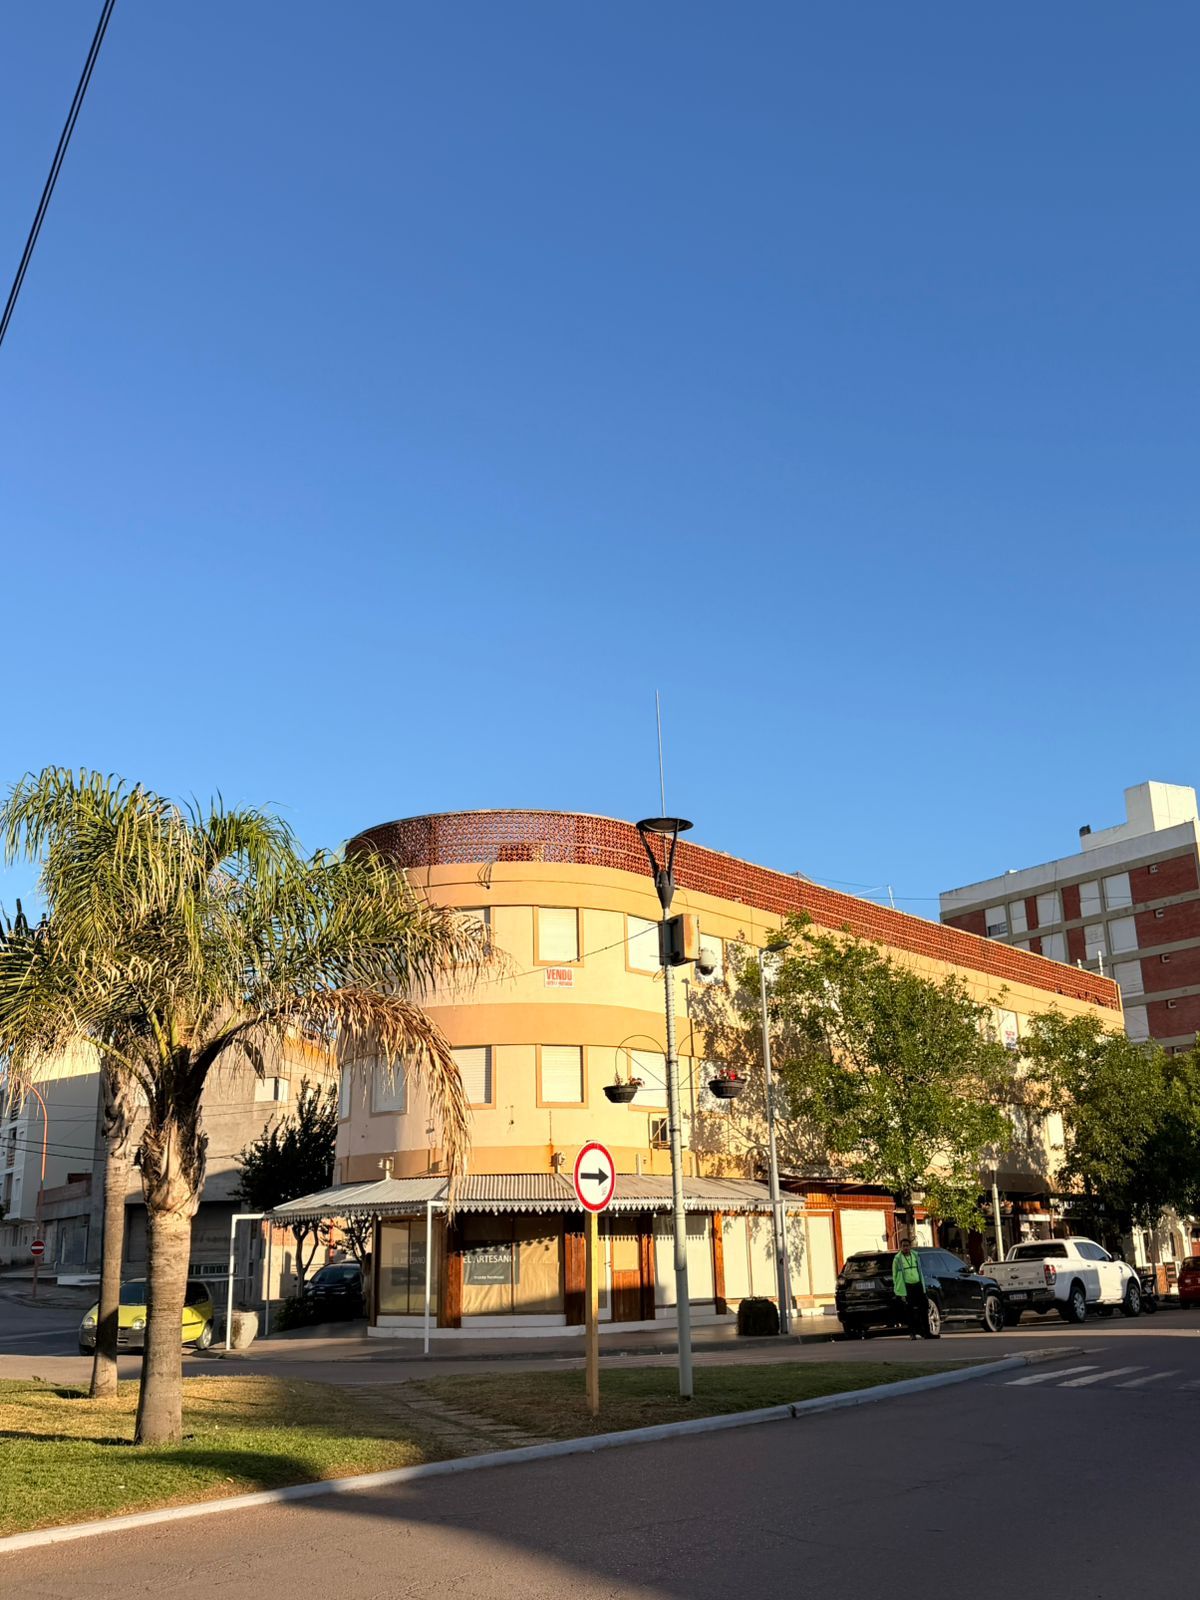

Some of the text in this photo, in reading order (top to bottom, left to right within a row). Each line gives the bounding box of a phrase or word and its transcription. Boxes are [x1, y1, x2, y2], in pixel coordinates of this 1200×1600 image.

[546, 969, 573, 980] VENDO
[463, 1254, 516, 1263] EL ARTESANO
